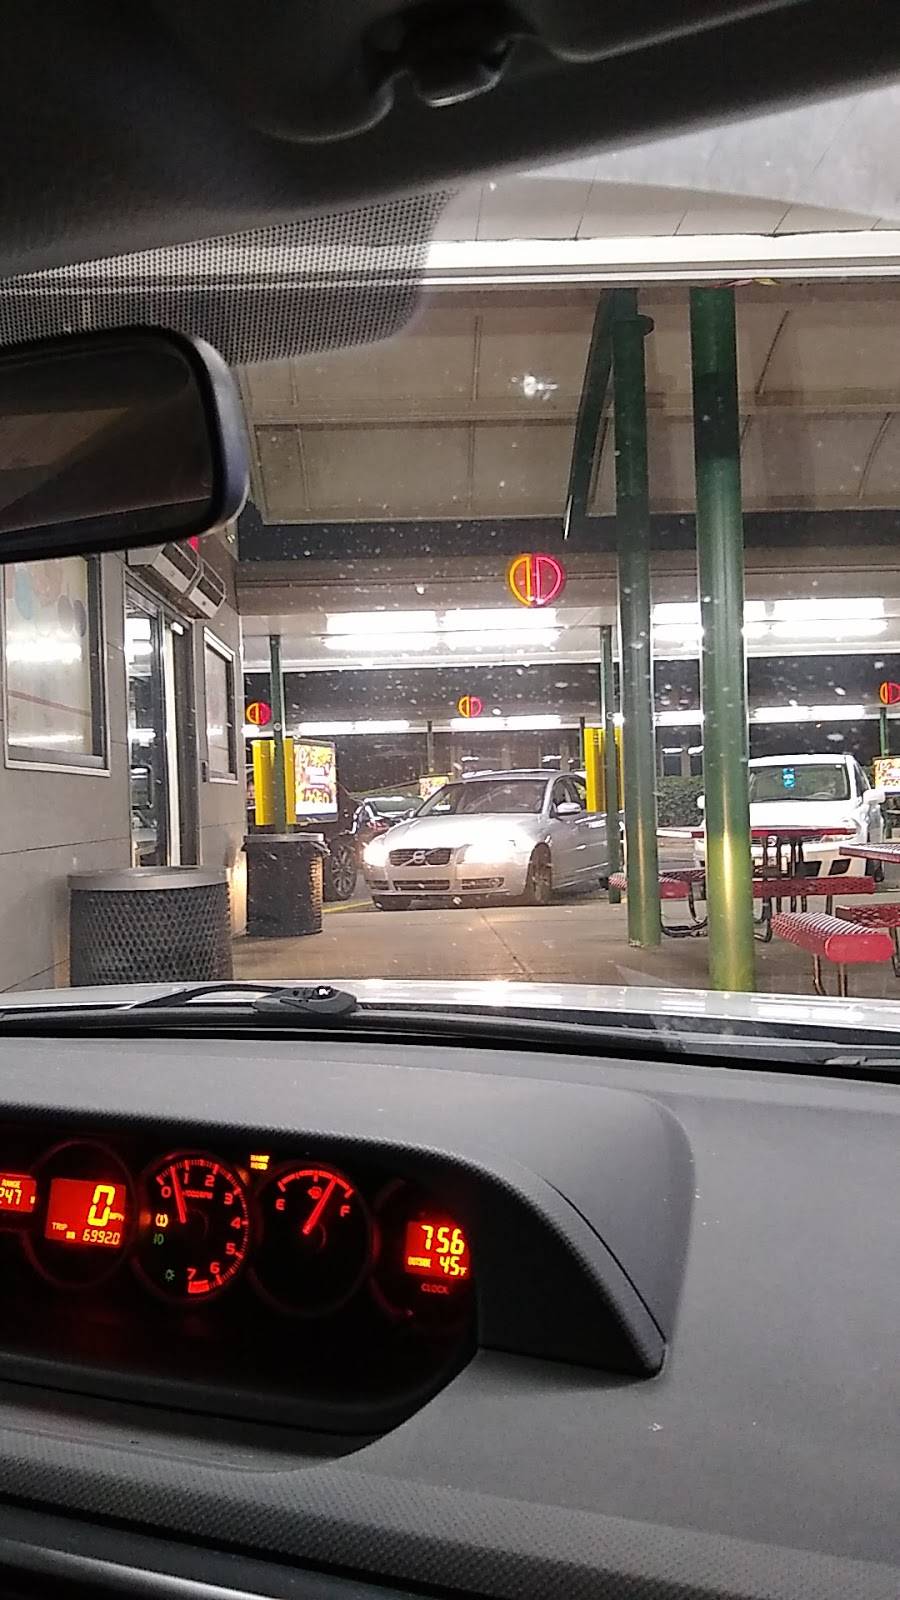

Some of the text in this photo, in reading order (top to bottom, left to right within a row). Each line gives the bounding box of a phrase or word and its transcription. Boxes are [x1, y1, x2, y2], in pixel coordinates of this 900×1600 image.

[184, 1172, 188, 1184] 1
[205, 1174, 215, 1186] 2
[161, 1185, 171, 1198] 0
[223, 1192, 233, 1205] 3
[275, 1198, 285, 1210] E
[87, 1184, 115, 1226] 0
[340, 1205, 350, 1217] F
[230, 1217, 240, 1228] 4
[225, 1242, 235, 1255] 5
[187, 1267, 196, 1279] 7
[209, 1262, 219, 1274] 6
[420, 1283, 449, 1293] CLOCK
